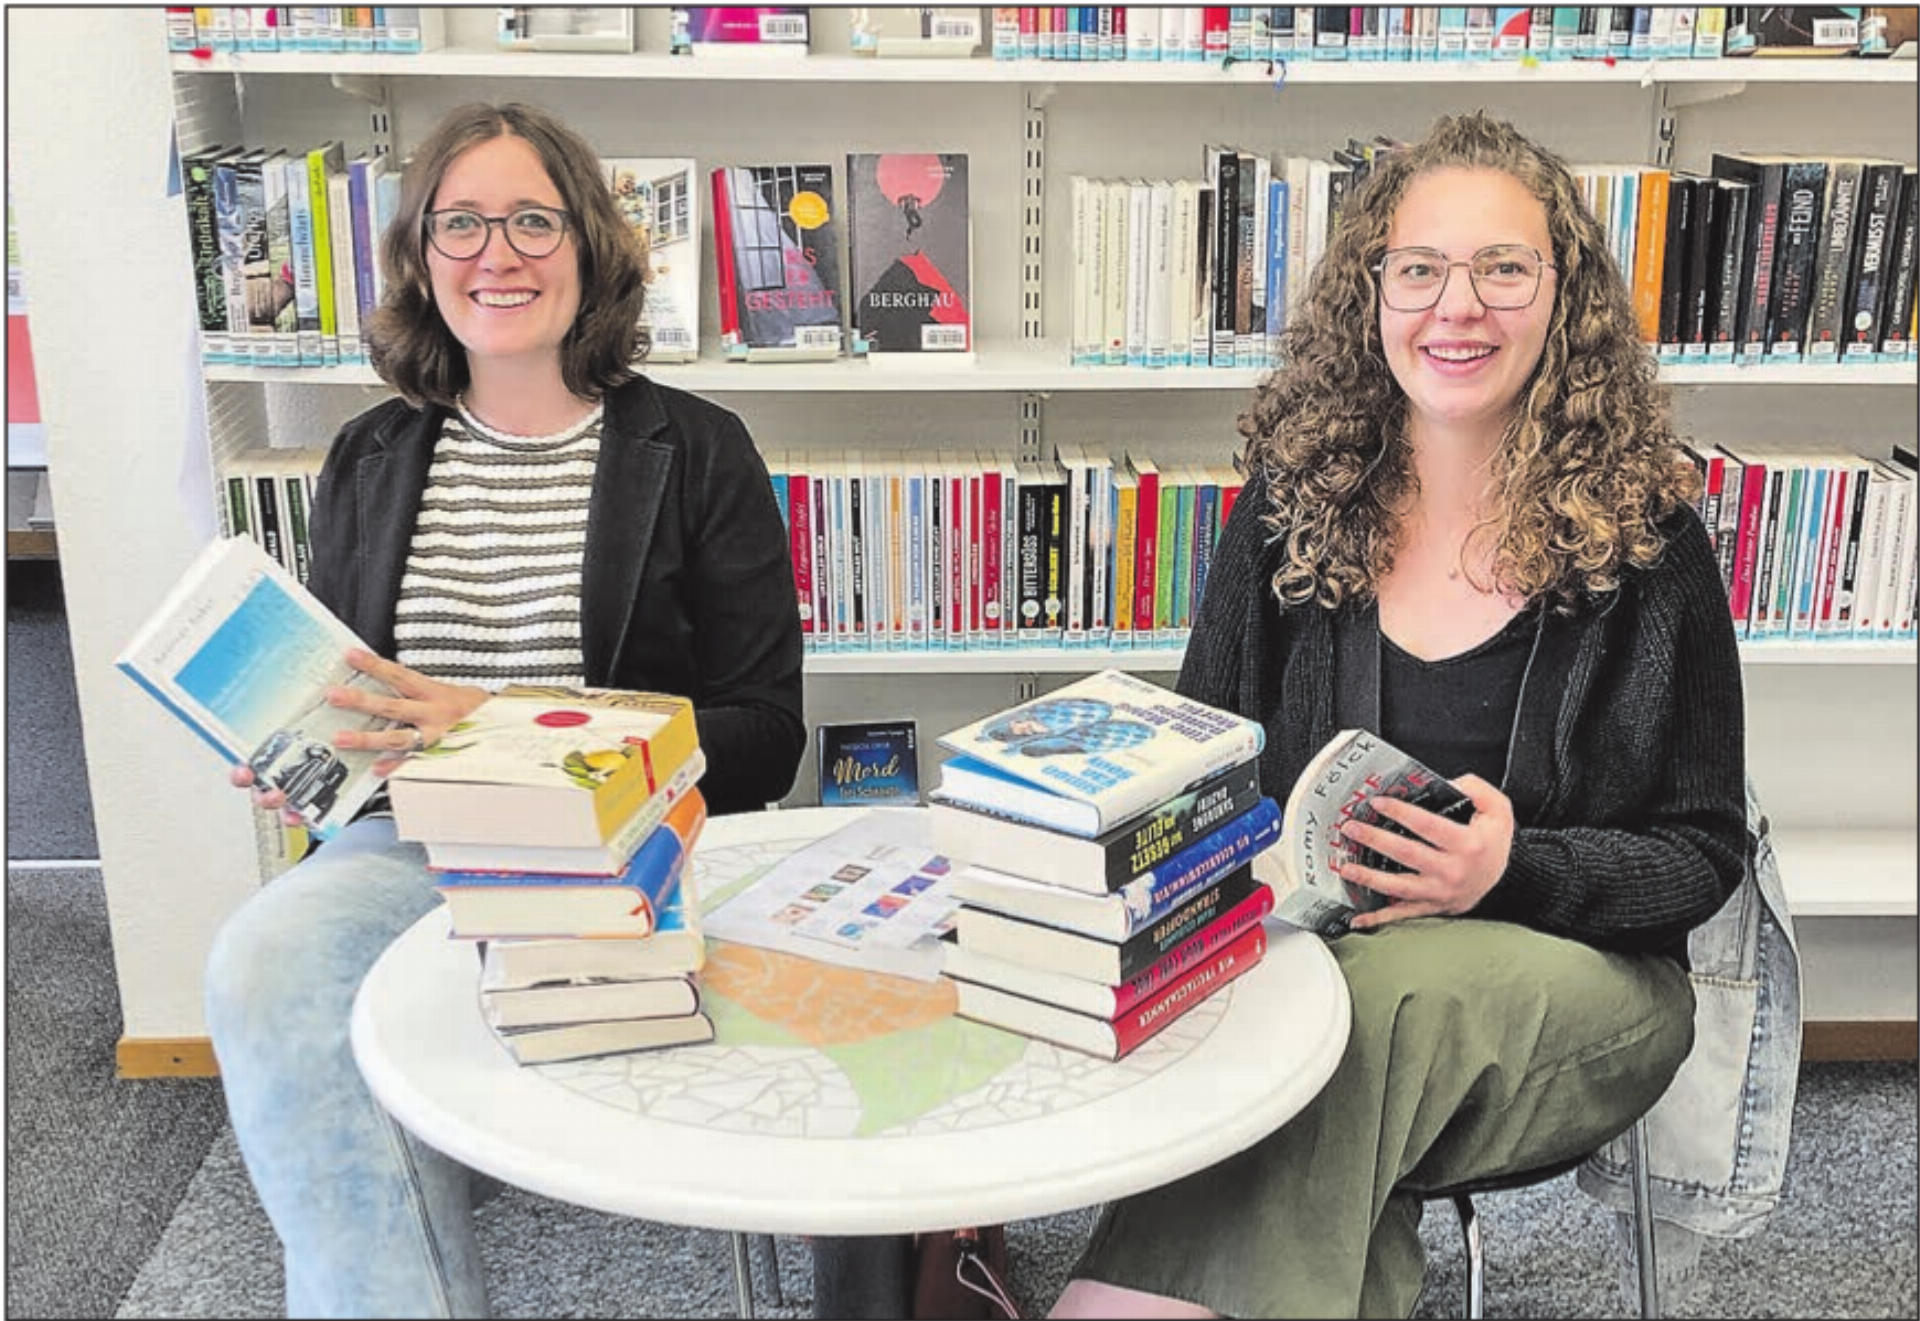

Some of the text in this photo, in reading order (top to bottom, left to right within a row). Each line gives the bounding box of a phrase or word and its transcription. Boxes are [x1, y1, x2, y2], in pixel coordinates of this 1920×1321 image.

[1789, 188, 1815, 232] FEIND
[1863, 212, 1887, 274] VERMISST
[745, 289, 836, 312] GESTEHT
[869, 292, 954, 308] BERGHAU
[833, 754, 899, 785] Mord
[1303, 740, 1375, 887] Romy Fölck
[1135, 818, 1163, 849] ELITE
[1130, 837, 1170, 874] GESETZ
